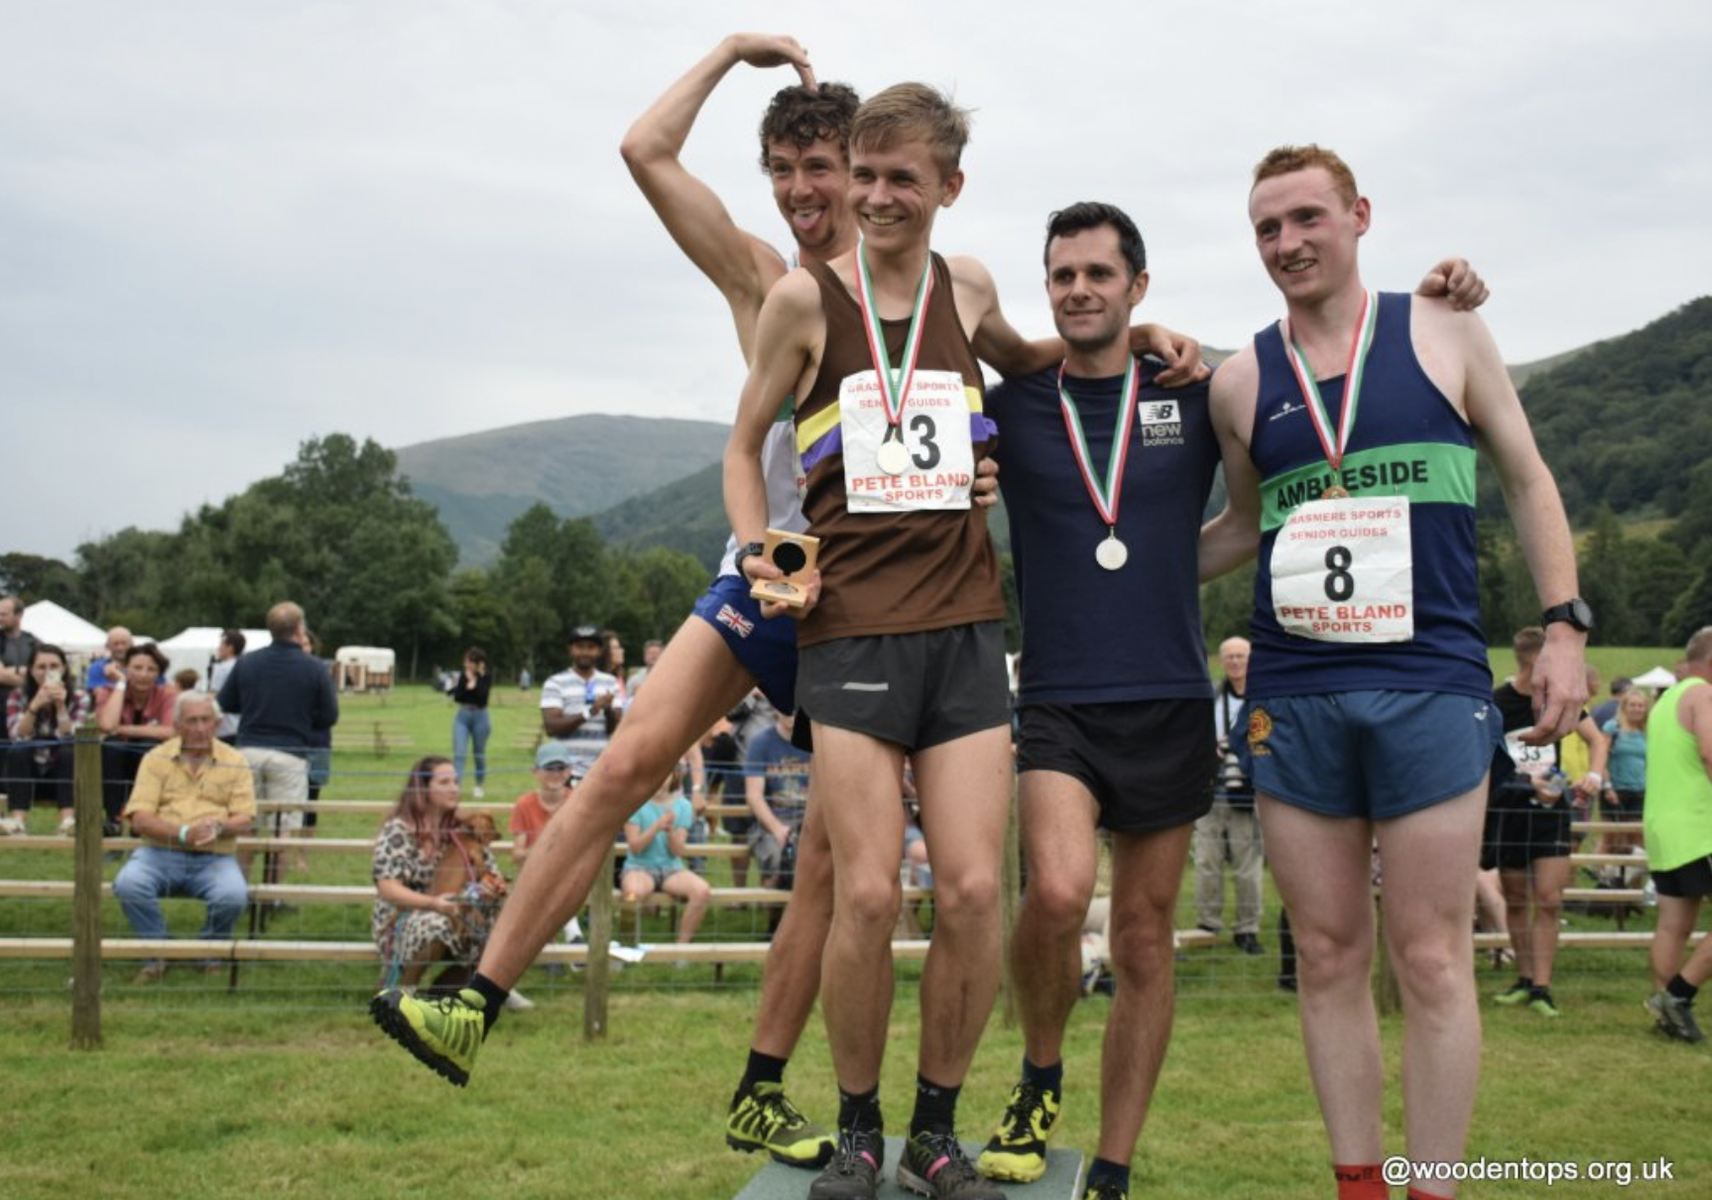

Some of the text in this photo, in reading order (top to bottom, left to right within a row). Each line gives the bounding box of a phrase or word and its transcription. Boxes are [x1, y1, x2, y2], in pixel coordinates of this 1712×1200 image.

[916, 381, 960, 391] SPORTS
[908, 398, 951, 408] GUIDES
[1142, 423, 1182, 438] new
[1143, 437, 1185, 447] balance
[852, 473, 970, 492] PETE BLAND
[884, 488, 944, 503] SPORTS
[1289, 506, 1402, 525] RASMERE SPORTS
[1290, 527, 1388, 540] SENIOR GUIDES
[1324, 545, 1355, 602] 8
[1281, 604, 1407, 620] PETE BLAND
[1311, 621, 1373, 633] SPORTS
